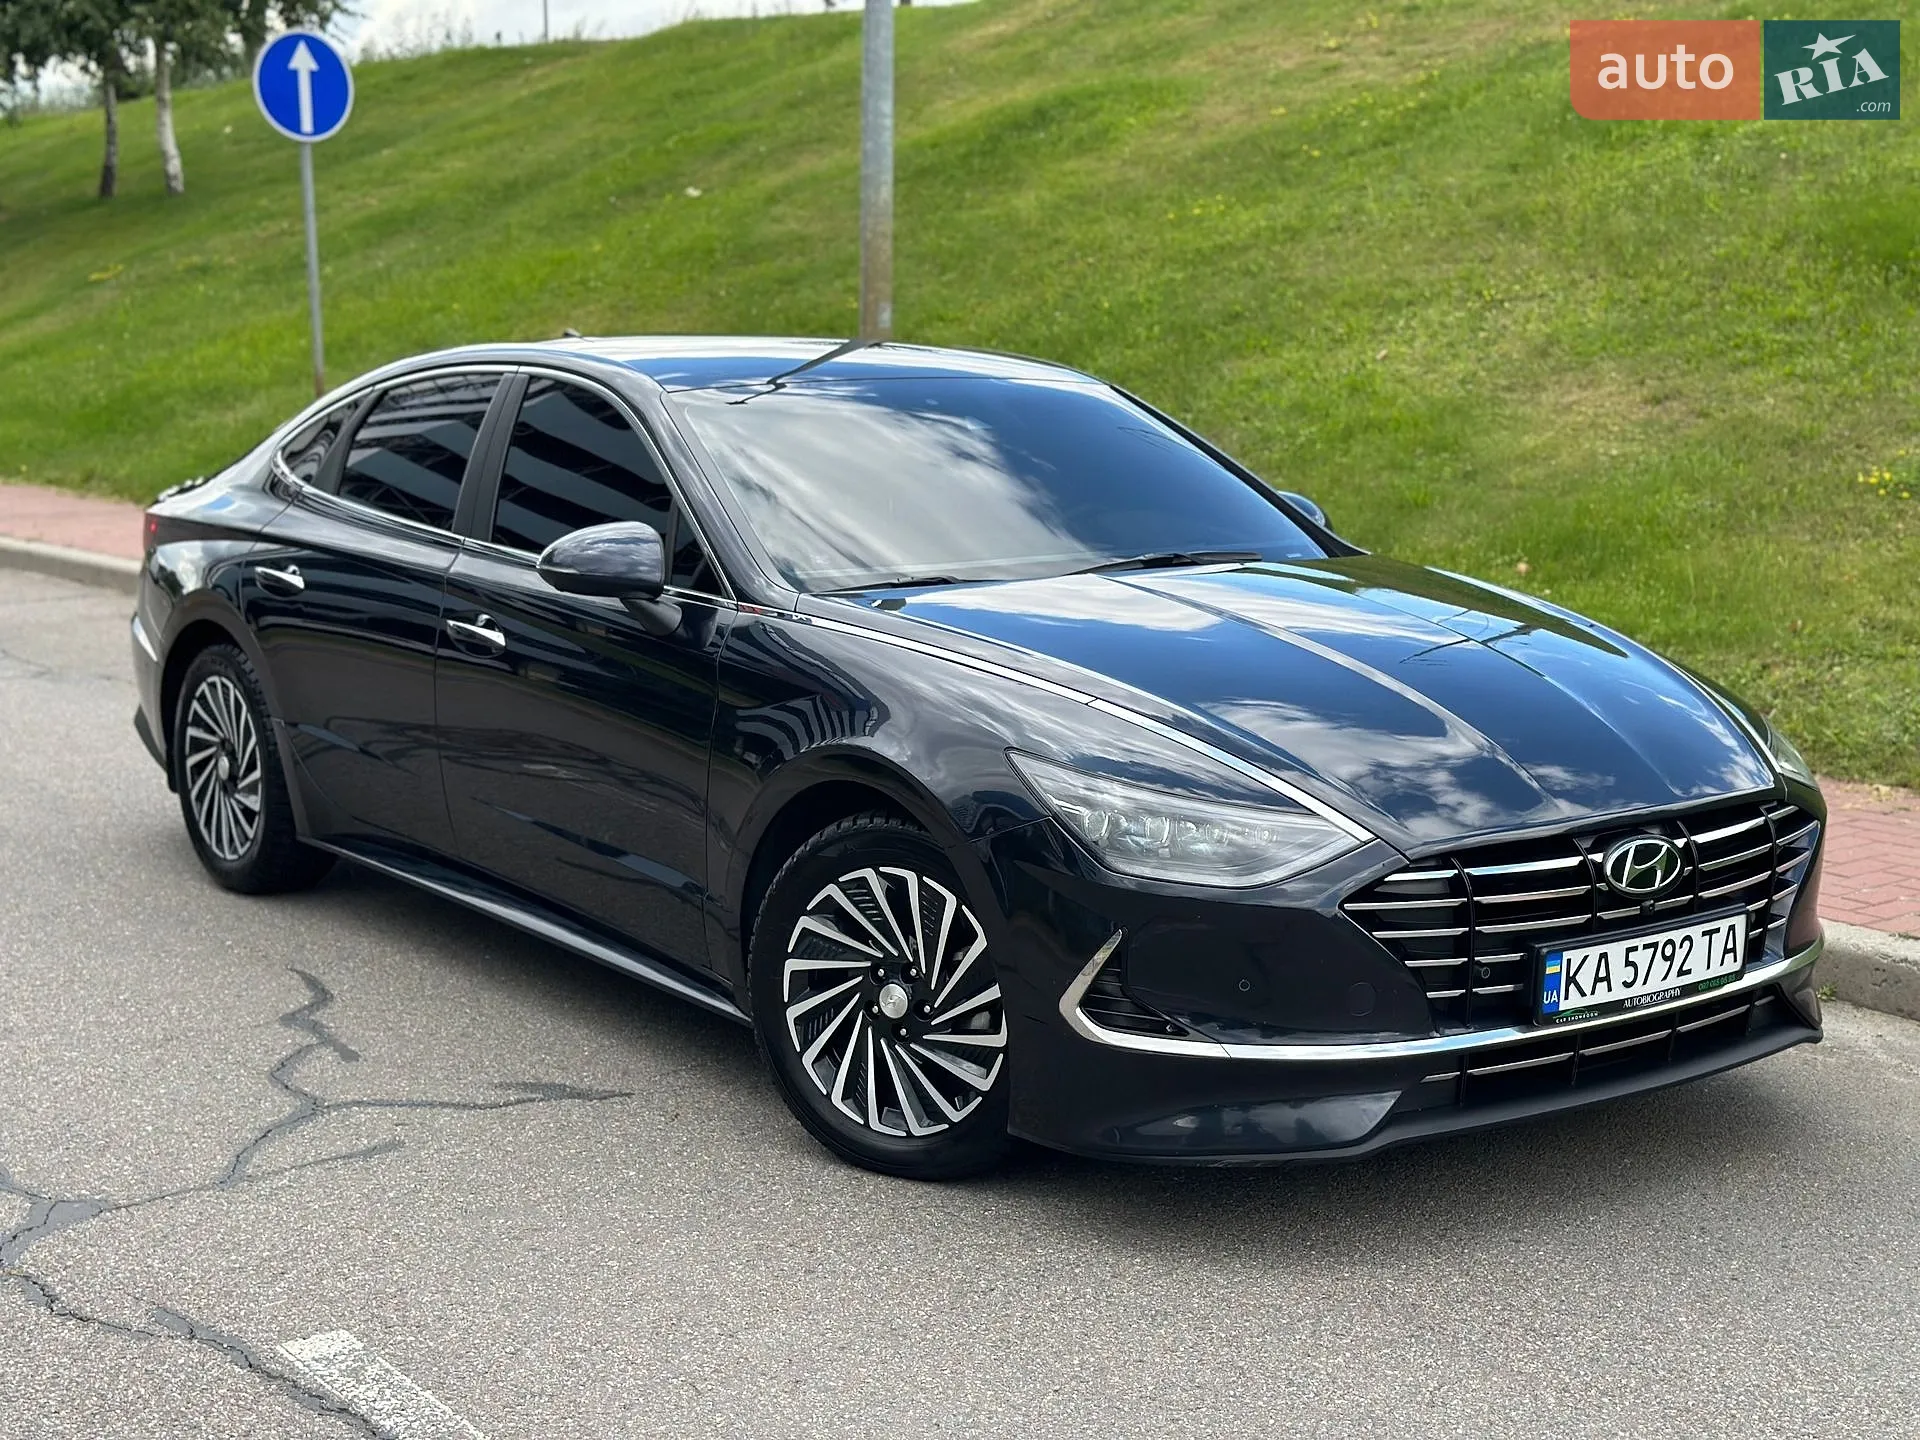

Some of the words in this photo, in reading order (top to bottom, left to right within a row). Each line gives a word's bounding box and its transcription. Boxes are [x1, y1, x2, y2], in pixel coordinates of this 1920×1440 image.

[1563, 951, 1613, 1001] KA
[1621, 934, 1694, 989] 5792
[1701, 923, 1738, 970] TA
[1543, 989, 1559, 1004] UA
[1622, 987, 1681, 1008] AUTOBIOGRAPHY
